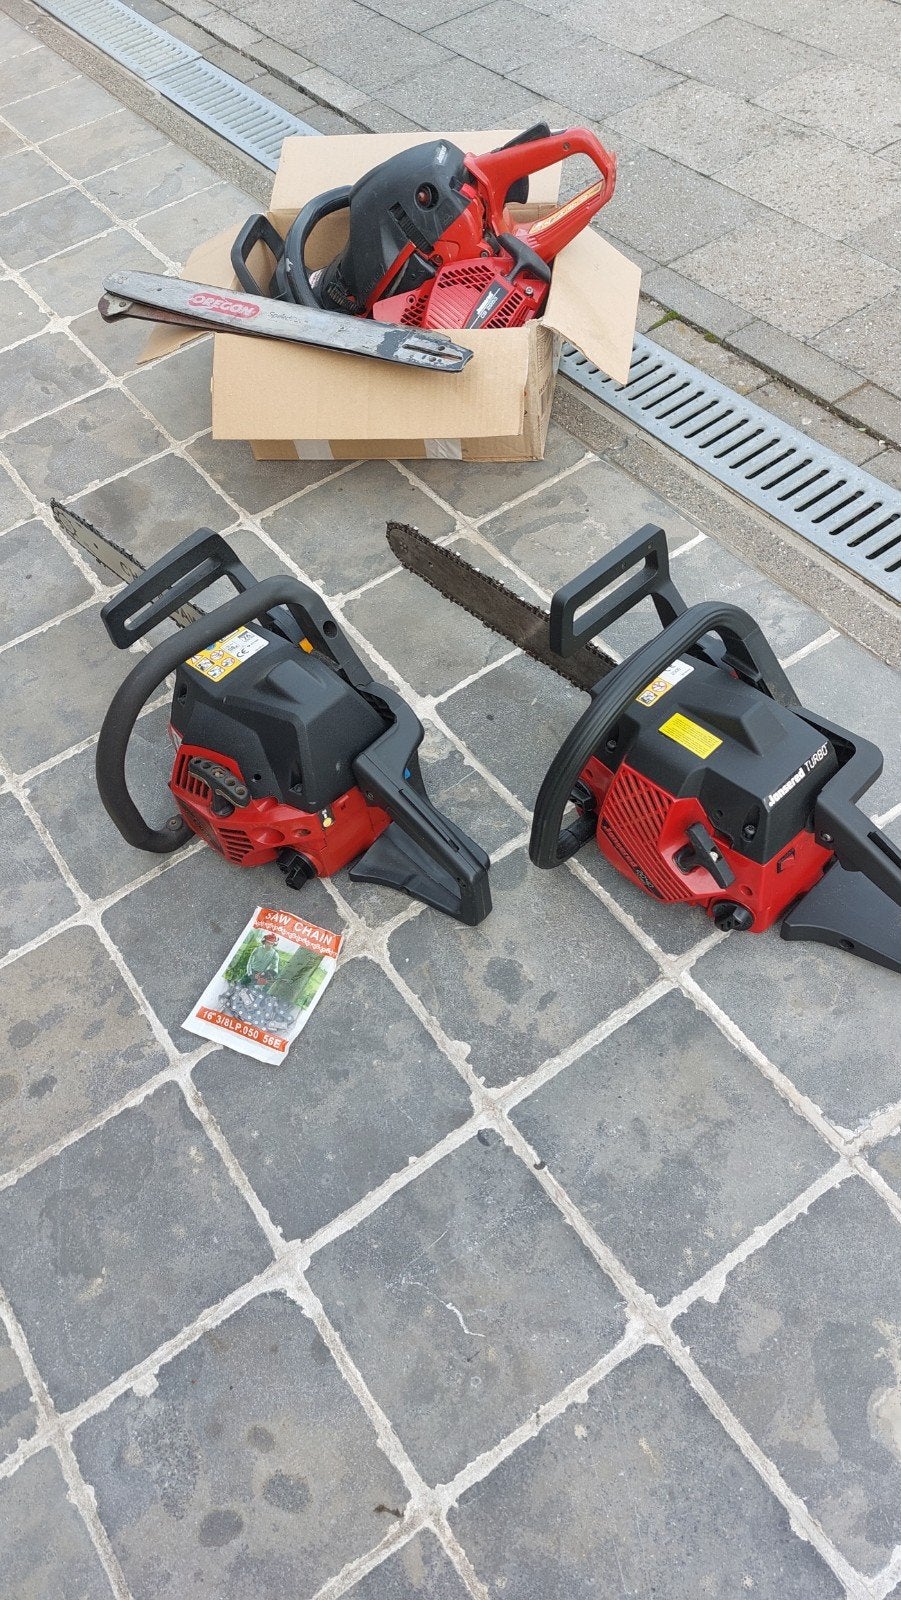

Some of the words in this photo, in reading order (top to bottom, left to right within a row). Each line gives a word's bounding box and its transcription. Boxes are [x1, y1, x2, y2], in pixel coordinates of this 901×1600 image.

[194, 295, 254, 315] OREGON
[768, 767, 806, 807] Jonsered
[804, 741, 828, 772] TURBO
[265, 912, 291, 925] SAW
[294, 922, 333, 945] CHAIN
[262, 1034, 281, 1048] 56E
